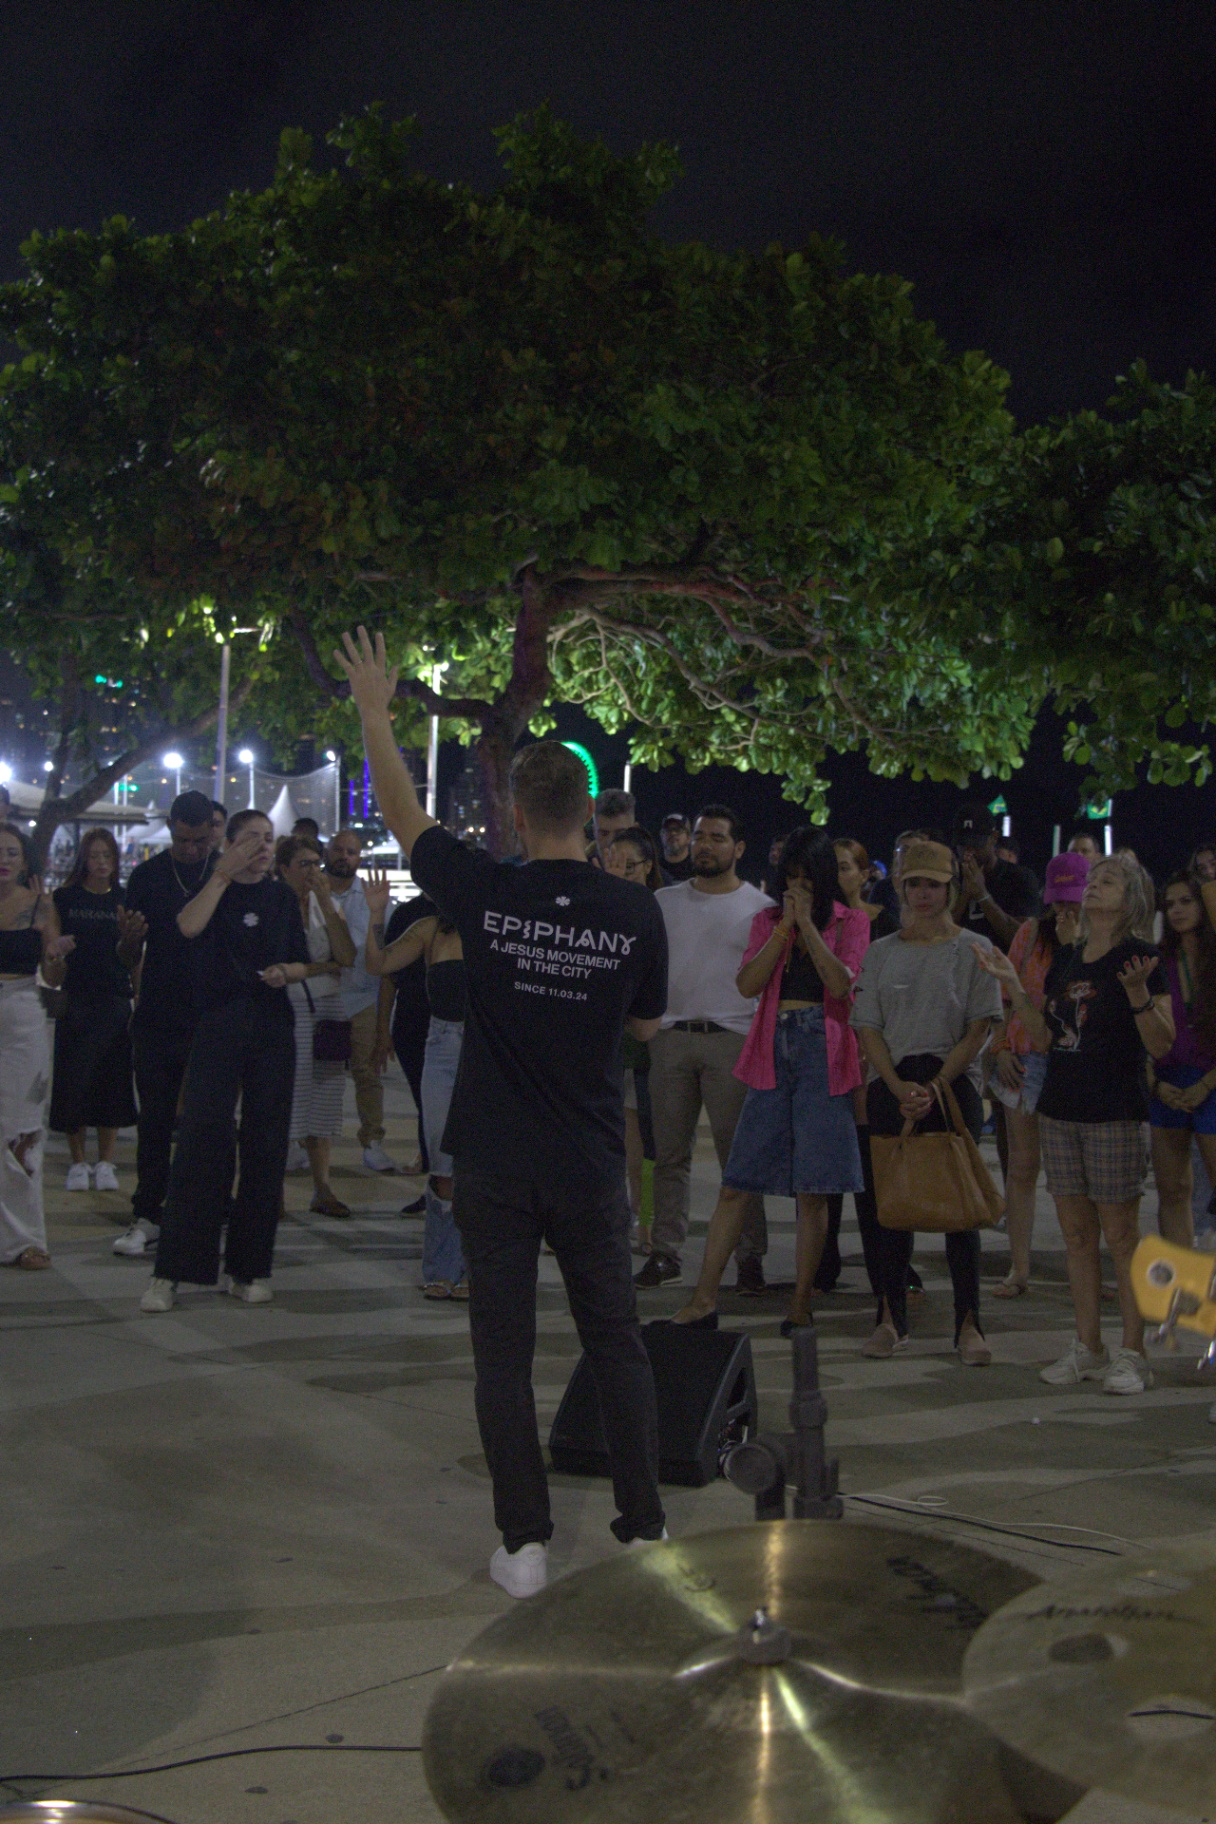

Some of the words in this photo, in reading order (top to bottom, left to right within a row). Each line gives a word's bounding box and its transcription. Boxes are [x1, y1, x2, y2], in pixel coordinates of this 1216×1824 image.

[490, 939, 499, 951] A
[500, 942, 545, 959] JESUS
[546, 949, 621, 971] MOVEMENT
[517, 957, 531, 971] IN
[533, 960, 560, 975] THE
[561, 965, 592, 980] CITY
[514, 981, 546, 995] SINCE
[548, 988, 588, 1001] 11.03.24
